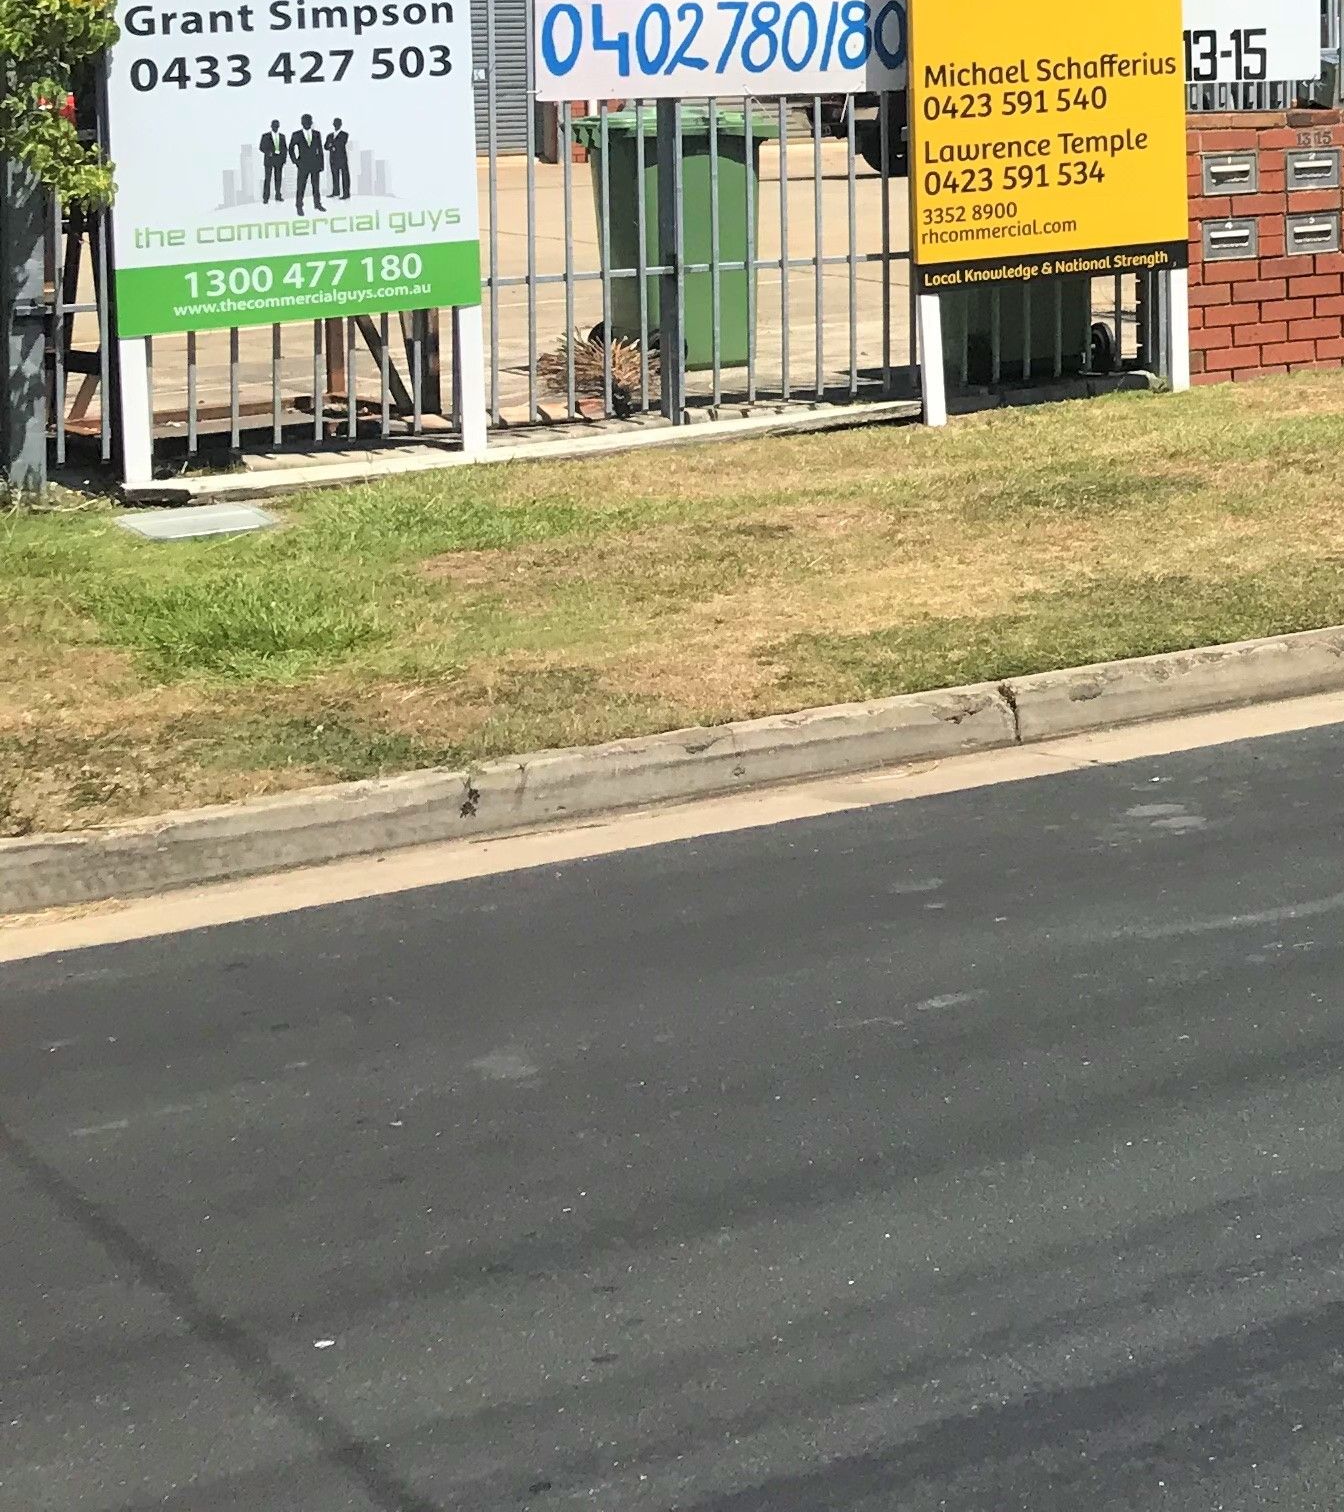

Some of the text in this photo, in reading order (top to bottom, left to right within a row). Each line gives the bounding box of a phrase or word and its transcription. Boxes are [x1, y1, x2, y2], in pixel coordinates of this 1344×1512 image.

[124, 3, 254, 37] Grant
[541, 0, 906, 77] 0402780180
[1182, 28, 1266, 81] 13-15
[129, 44, 453, 92] 0433 427 503
[924, 52, 1177, 88] Michael Schafferius
[923, 85, 1107, 120] 0423 591 540
[924, 128, 1148, 164] Lawrence Temple
[924, 160, 1105, 195] 0423 591 534
[133, 206, 462, 250] the commercial guys
[922, 201, 1018, 225] 3352 8900
[920, 218, 1077, 245] rhcommercial.com
[184, 252, 423, 298] 1300 477 180
[924, 250, 1169, 287] Local Knowledge & National Strength
[173, 282, 431, 317] www.thecommercialguys.com.au
